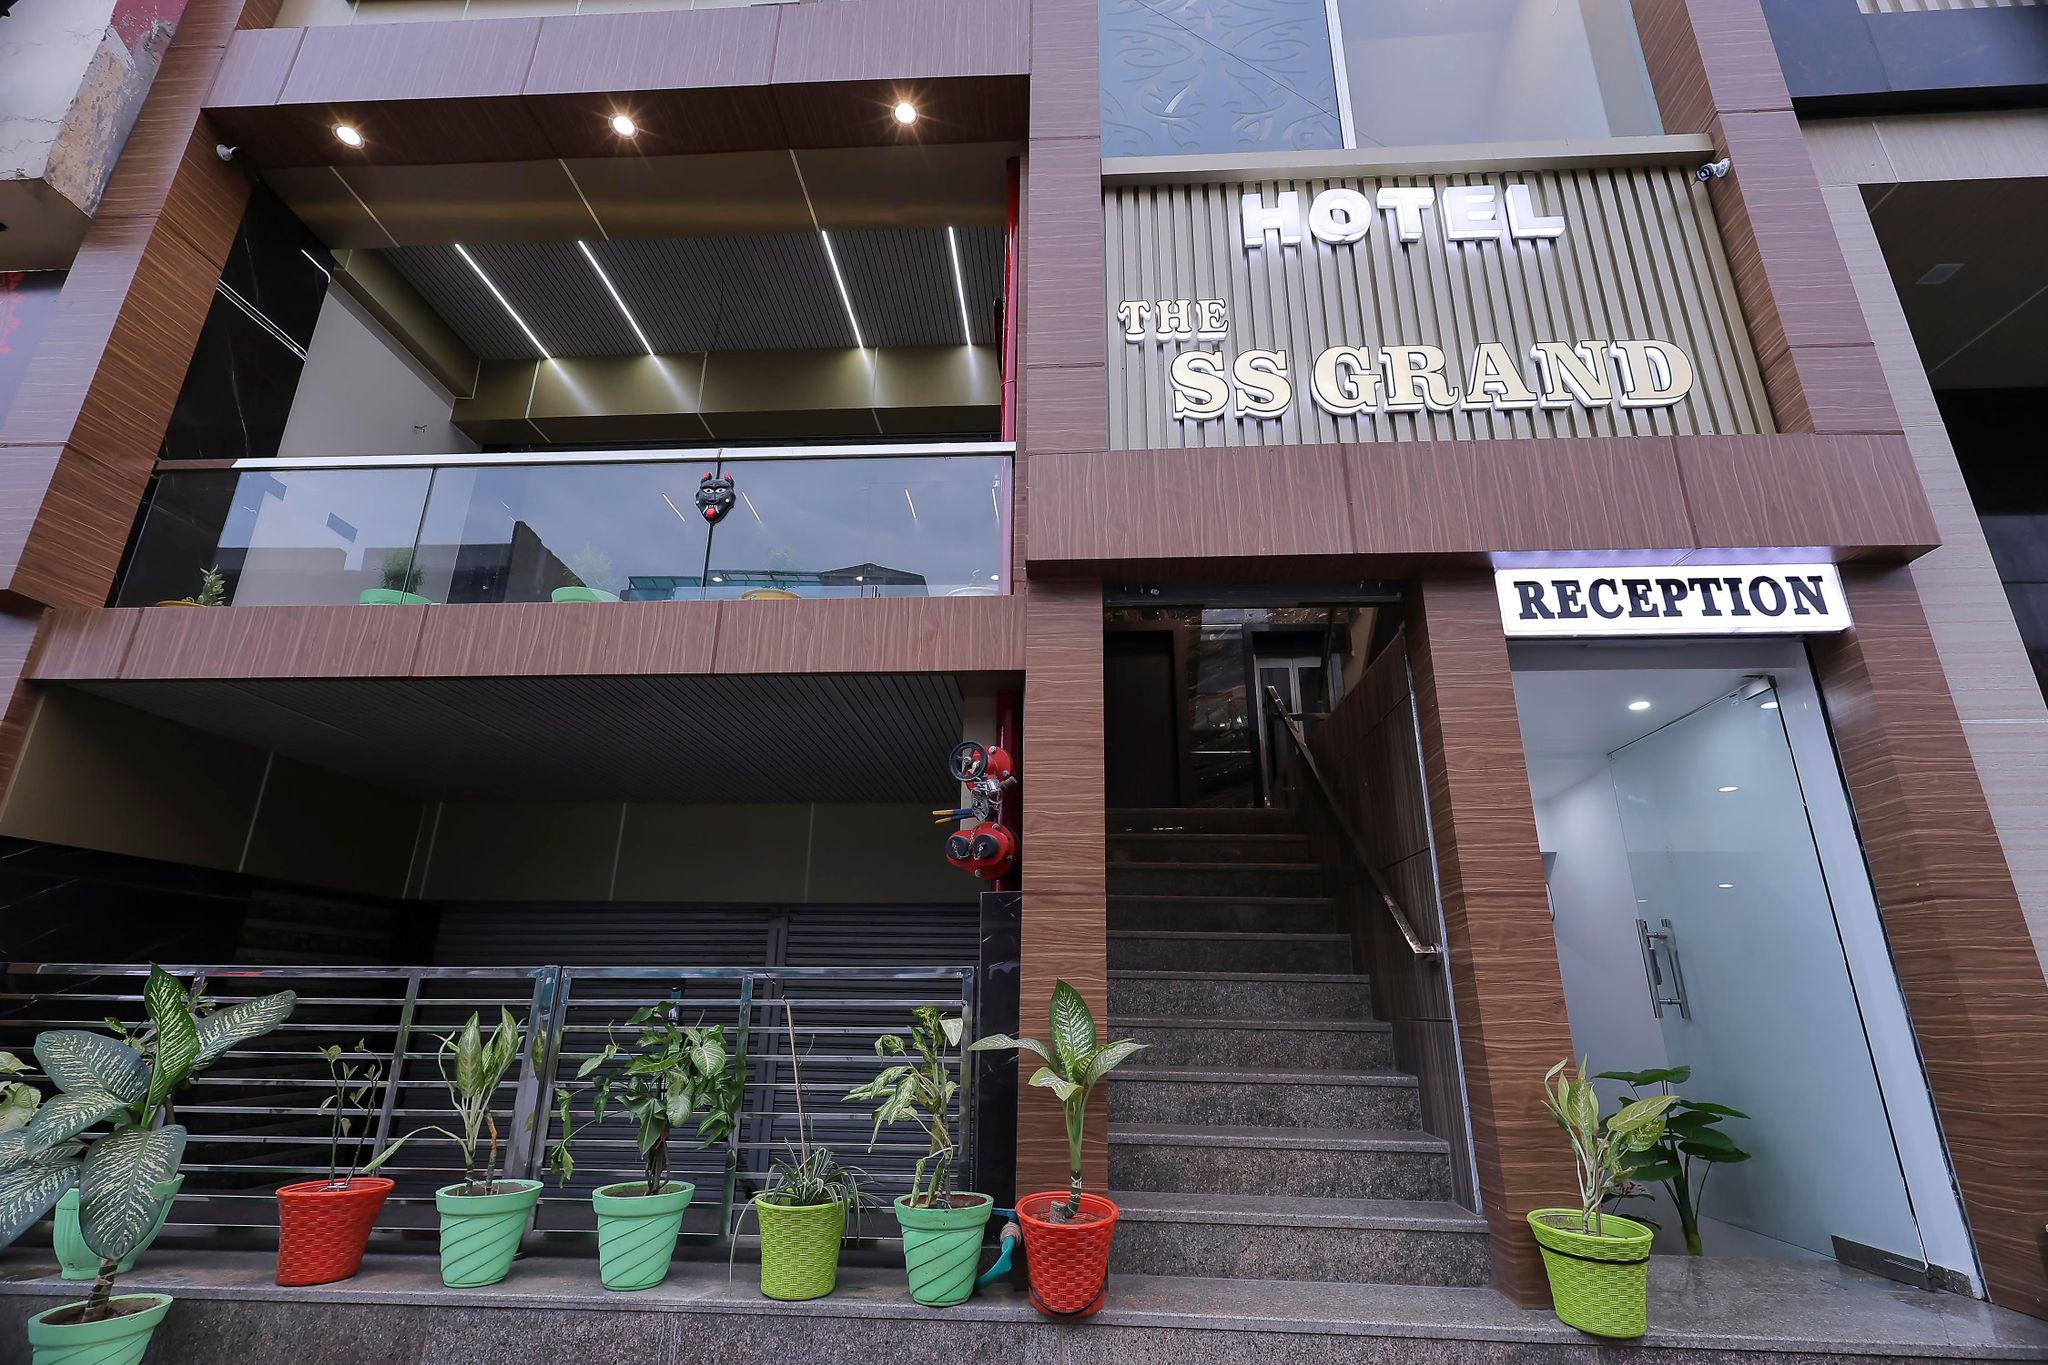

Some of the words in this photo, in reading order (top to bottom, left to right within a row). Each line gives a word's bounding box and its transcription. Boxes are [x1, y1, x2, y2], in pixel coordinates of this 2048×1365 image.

[1241, 185, 1565, 248] HOTEL
[1118, 298, 1230, 342] THE
[1171, 349, 1293, 420] SS
[1310, 339, 1694, 416] GRAND
[1513, 575, 1829, 620] RECEPTION
